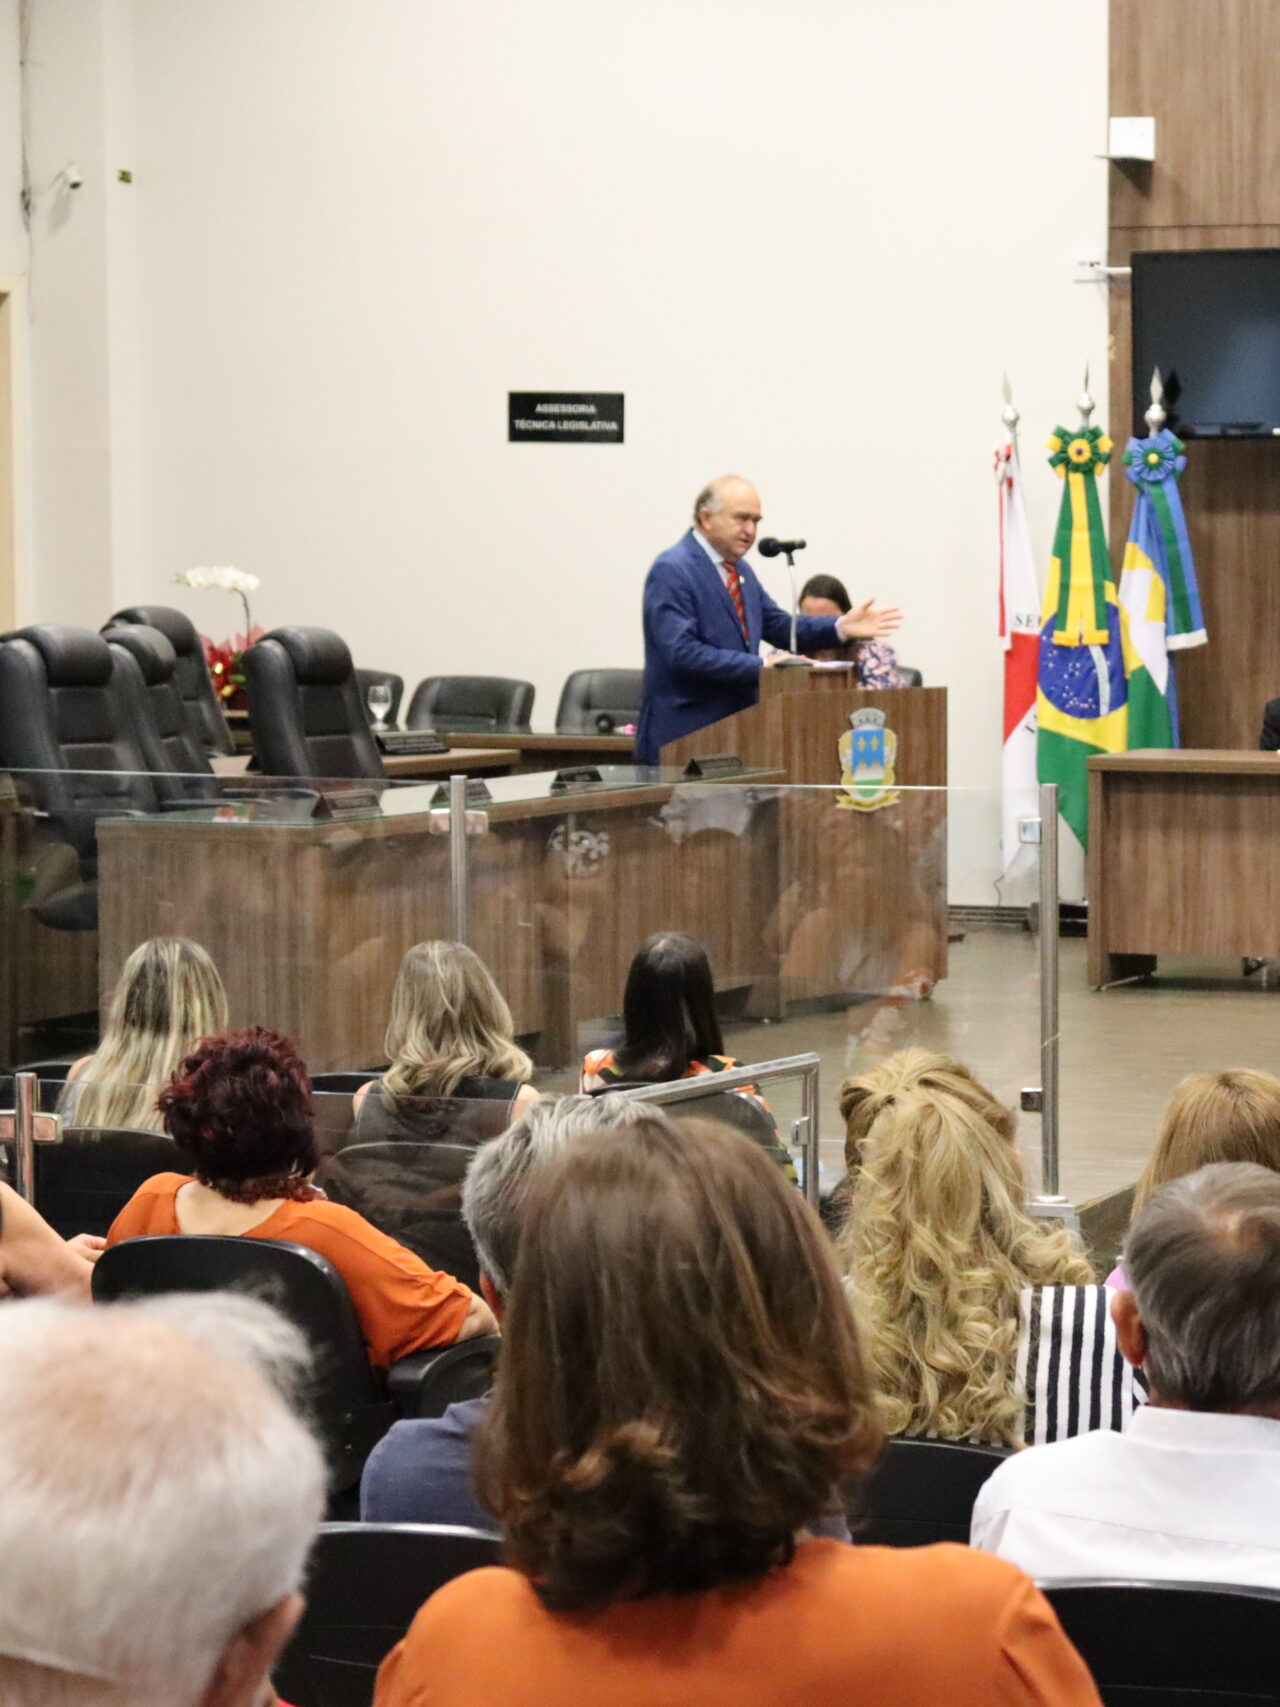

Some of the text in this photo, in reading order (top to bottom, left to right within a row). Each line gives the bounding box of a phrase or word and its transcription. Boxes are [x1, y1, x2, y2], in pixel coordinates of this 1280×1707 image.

[535, 403, 597, 414] ASSESSORIA
[514, 418, 618, 431] TÉCNICA LEGISLATIVA
